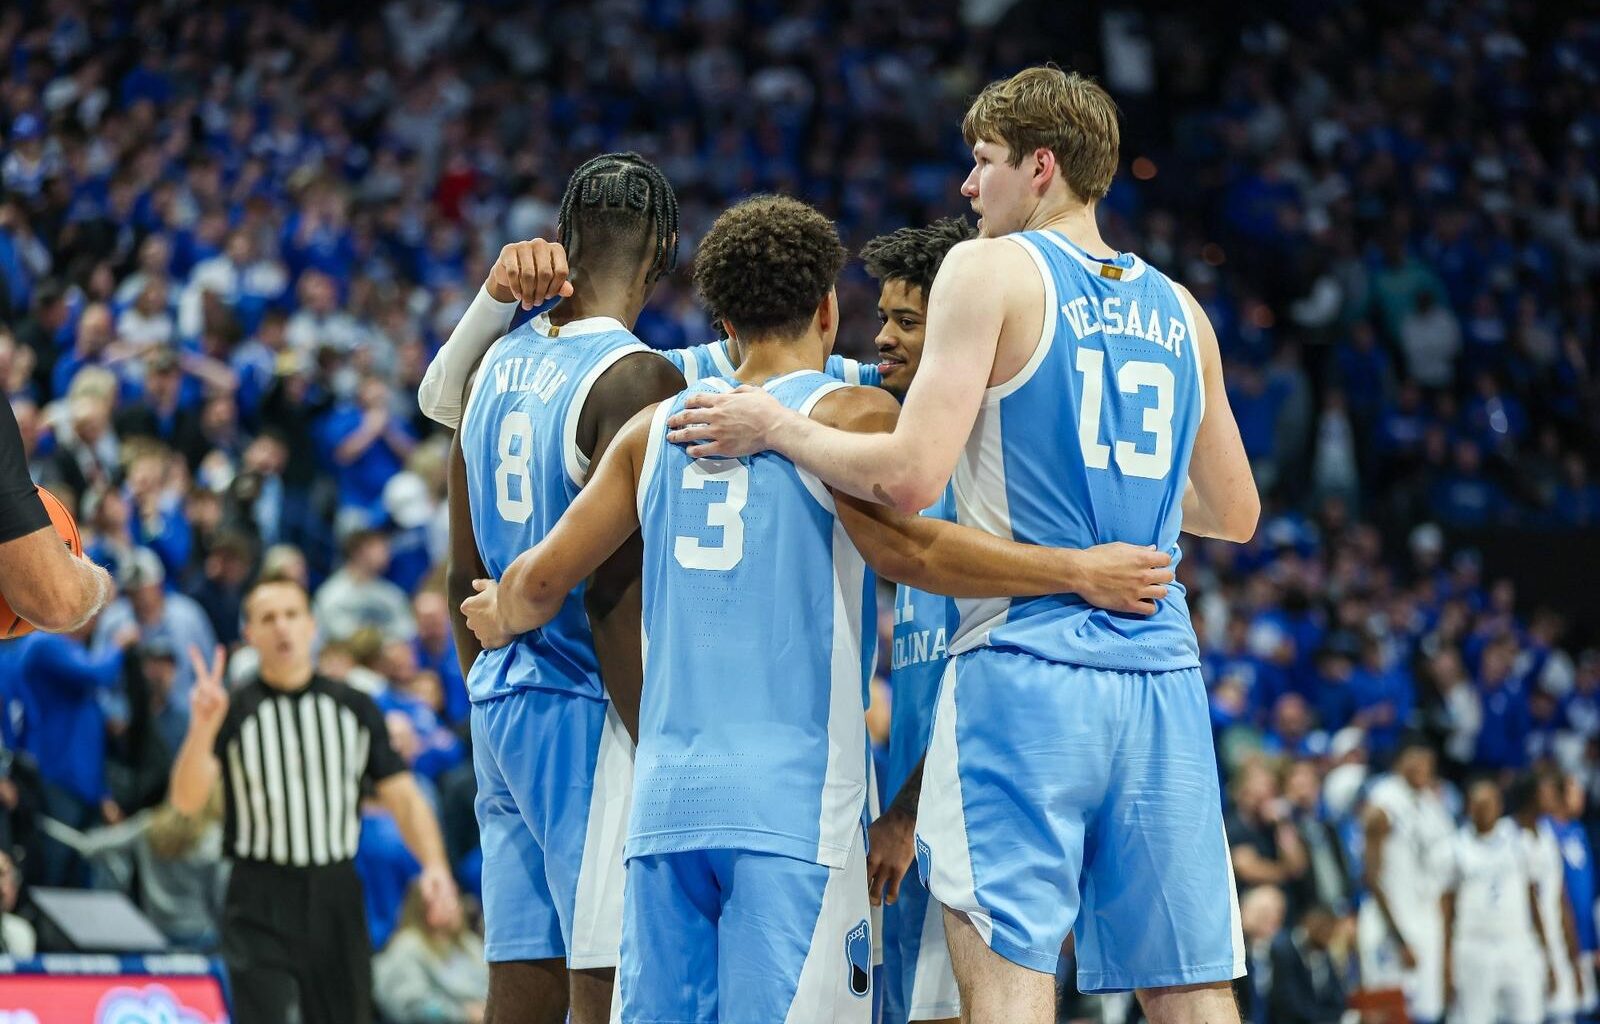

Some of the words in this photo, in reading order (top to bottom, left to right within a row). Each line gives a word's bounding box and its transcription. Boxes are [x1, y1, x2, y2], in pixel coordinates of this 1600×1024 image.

[495, 411, 533, 524] 8
[1076, 347, 1175, 480] 13
[674, 458, 749, 571] 3
